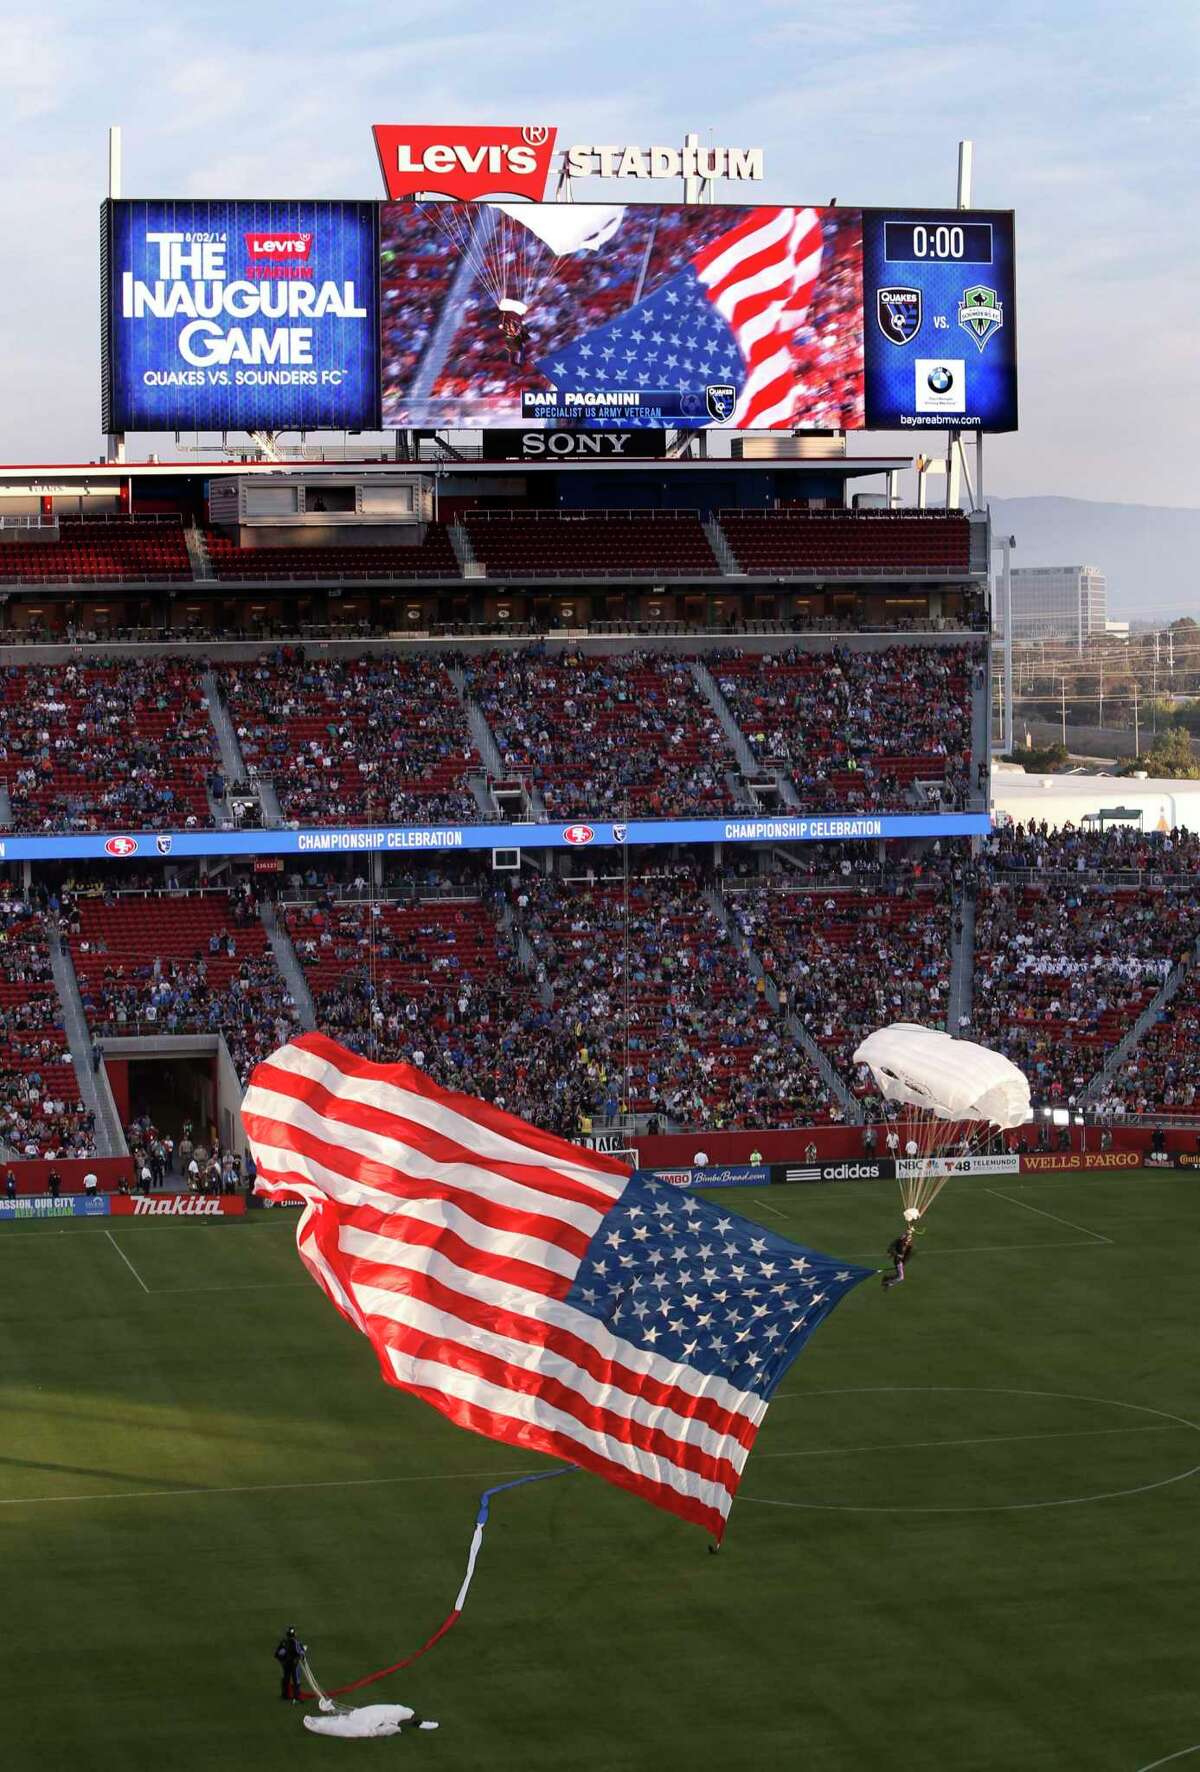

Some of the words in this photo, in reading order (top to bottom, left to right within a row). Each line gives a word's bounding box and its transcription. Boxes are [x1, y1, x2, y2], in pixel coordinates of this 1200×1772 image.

[567, 145, 764, 180] STADIUM
[186, 232, 227, 242] 8/02/14
[913, 226, 964, 258] 0:00
[146, 233, 226, 279] THE
[122, 272, 367, 318] INAUGURAL
[881, 292, 917, 302] QUAKES
[933, 316, 949, 328] VS.
[178, 320, 313, 367] GAME
[144, 371, 205, 385] QUAKES
[208, 371, 232, 385] VS.
[235, 370, 317, 385] SOUNDERS
[524, 393, 557, 405] DAN
[565, 393, 640, 405] PAGANINI
[535, 407, 582, 418] SPECIALIST
[585, 407, 596, 417] US
[599, 407, 622, 417] ARMY
[624, 407, 662, 417] VETERAN
[900, 414, 981, 426] bayareabmw.com
[522, 433, 631, 454] SONY
[725, 823, 807, 839] CHAMPIONSHIP
[810, 821, 881, 836] CELEBRATION
[298, 834, 384, 850] CHAMPIONSHIP
[387, 831, 462, 847] CELEBRATION
[898, 1160, 923, 1171] NBC
[954, 1160, 971, 1171] 48
[973, 1159, 1017, 1167] TELEMUNDO
[1023, 1156, 1080, 1169] WELLS
[1085, 1153, 1139, 1167] FARGO
[823, 1163, 879, 1179] adidas
[34, 1198, 53, 1209] OUR
